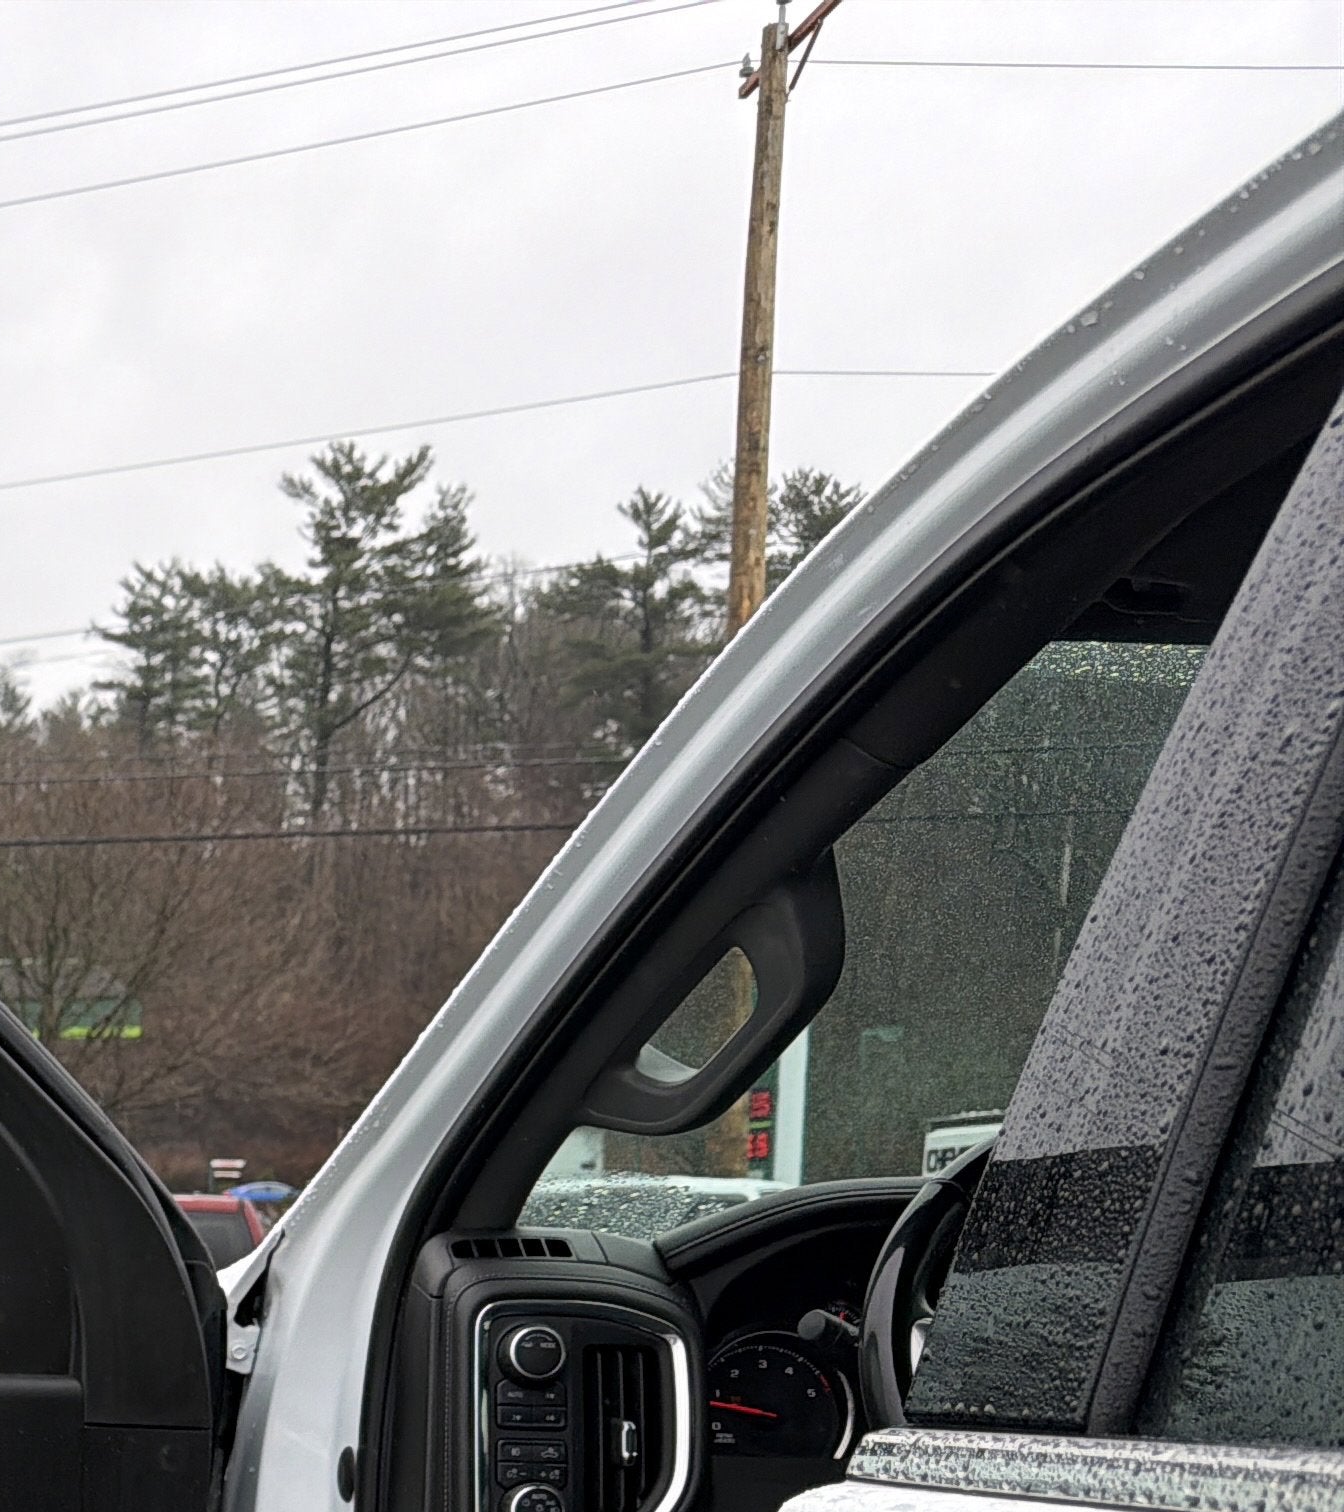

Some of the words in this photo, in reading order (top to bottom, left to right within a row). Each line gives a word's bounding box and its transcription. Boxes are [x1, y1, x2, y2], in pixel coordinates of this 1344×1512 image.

[758, 1359, 768, 1369] 3
[730, 1369, 740, 1378] 2
[784, 1366, 794, 1375] 4
[807, 1388, 816, 1398] 5
